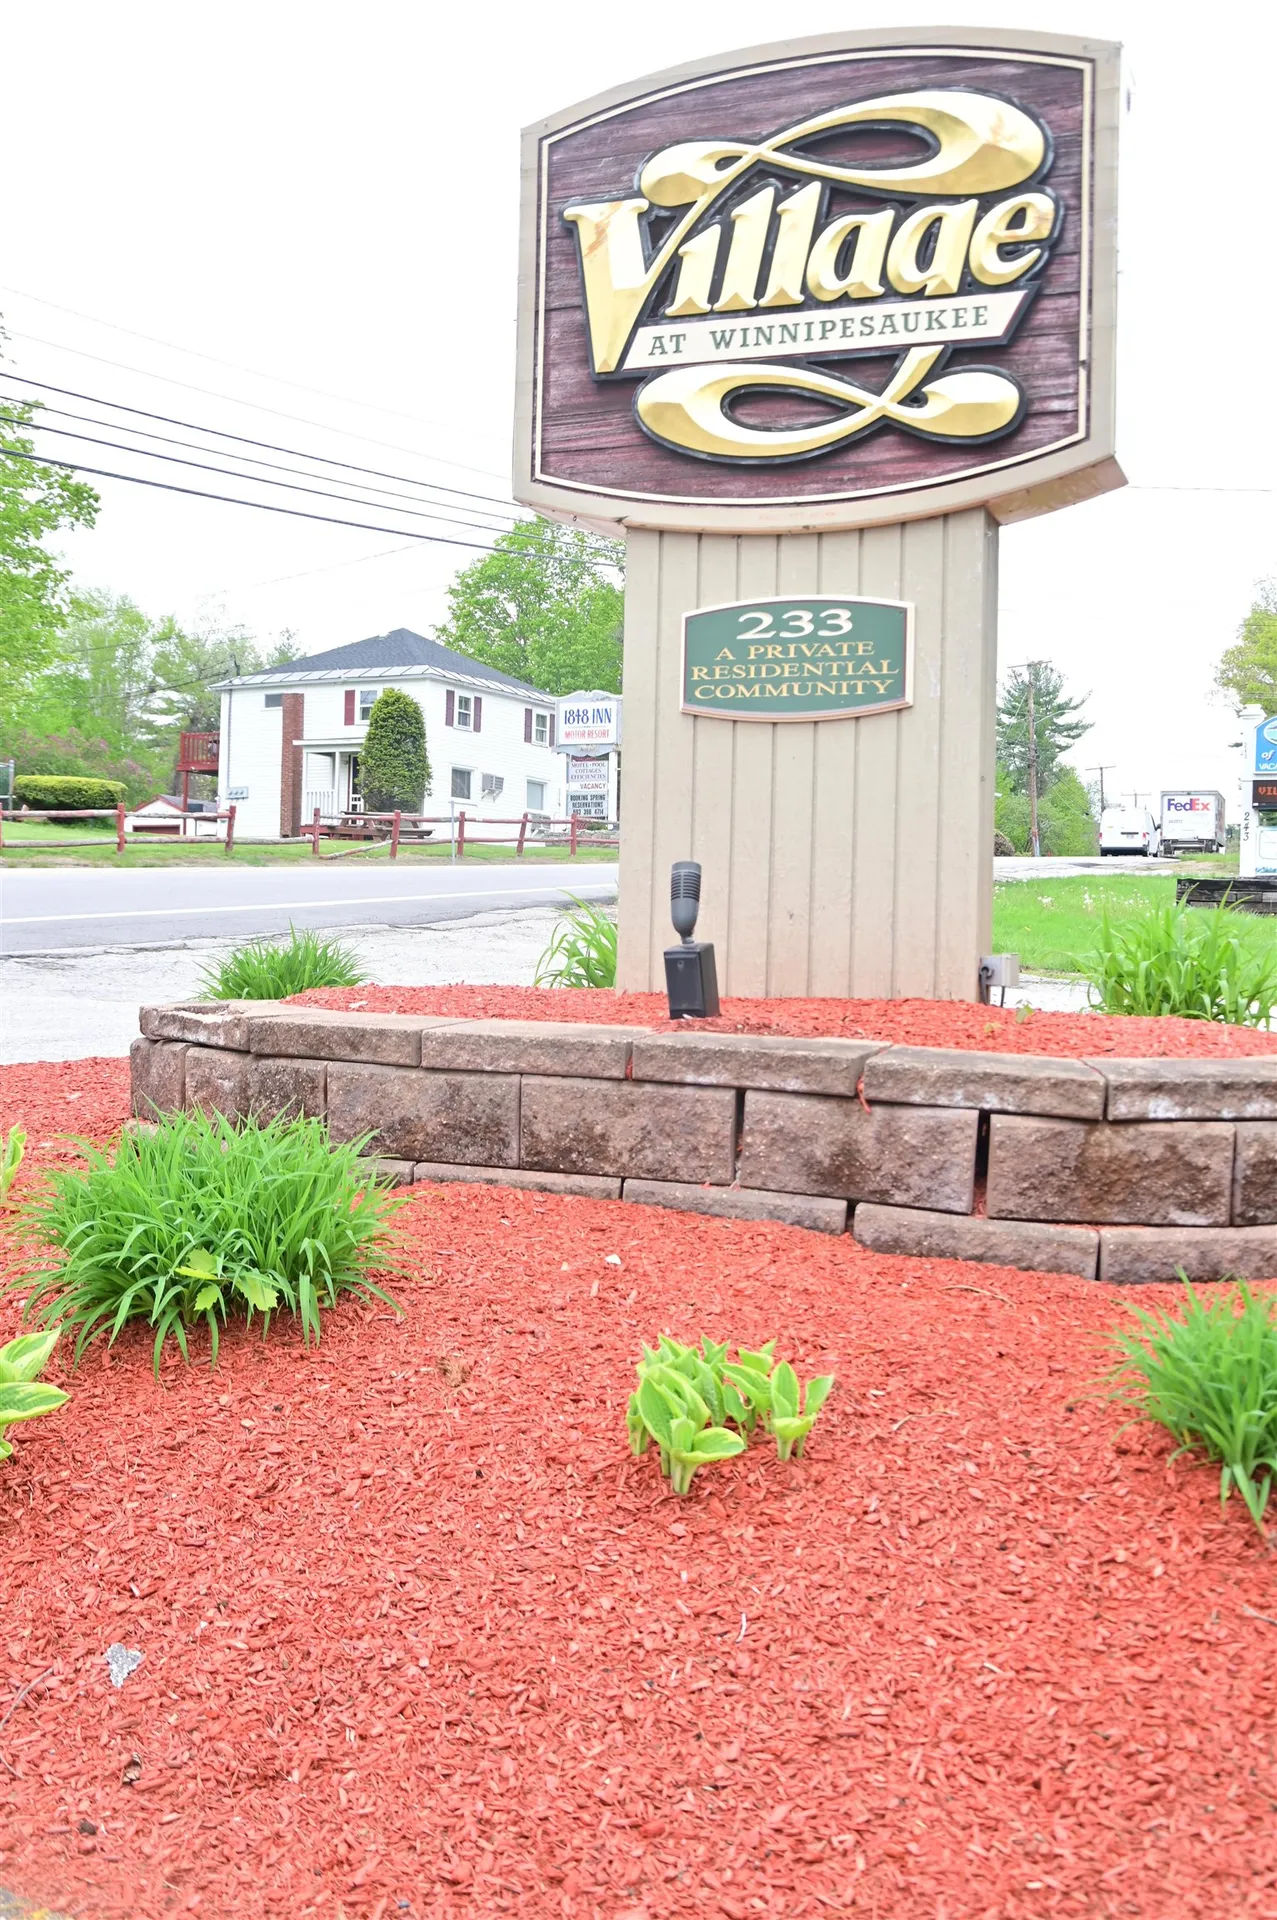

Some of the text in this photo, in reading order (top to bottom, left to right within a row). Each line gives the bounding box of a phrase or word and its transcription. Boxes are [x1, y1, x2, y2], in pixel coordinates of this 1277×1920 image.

[562, 87, 1057, 375] Village
[648, 304, 990, 356] AT WINNIPESAUKEE
[736, 608, 853, 640] 233
[714, 641, 875, 661] A PRIVATE
[691, 659, 900, 681] RESIDENTIAL
[694, 679, 895, 700] COMMUNITY
[564, 708, 612, 724] 1848 INN
[565, 729, 610, 739] MOTOR RESORT
[1261, 750, 1275, 760] of
[1167, 798, 1210, 811] FedEx
